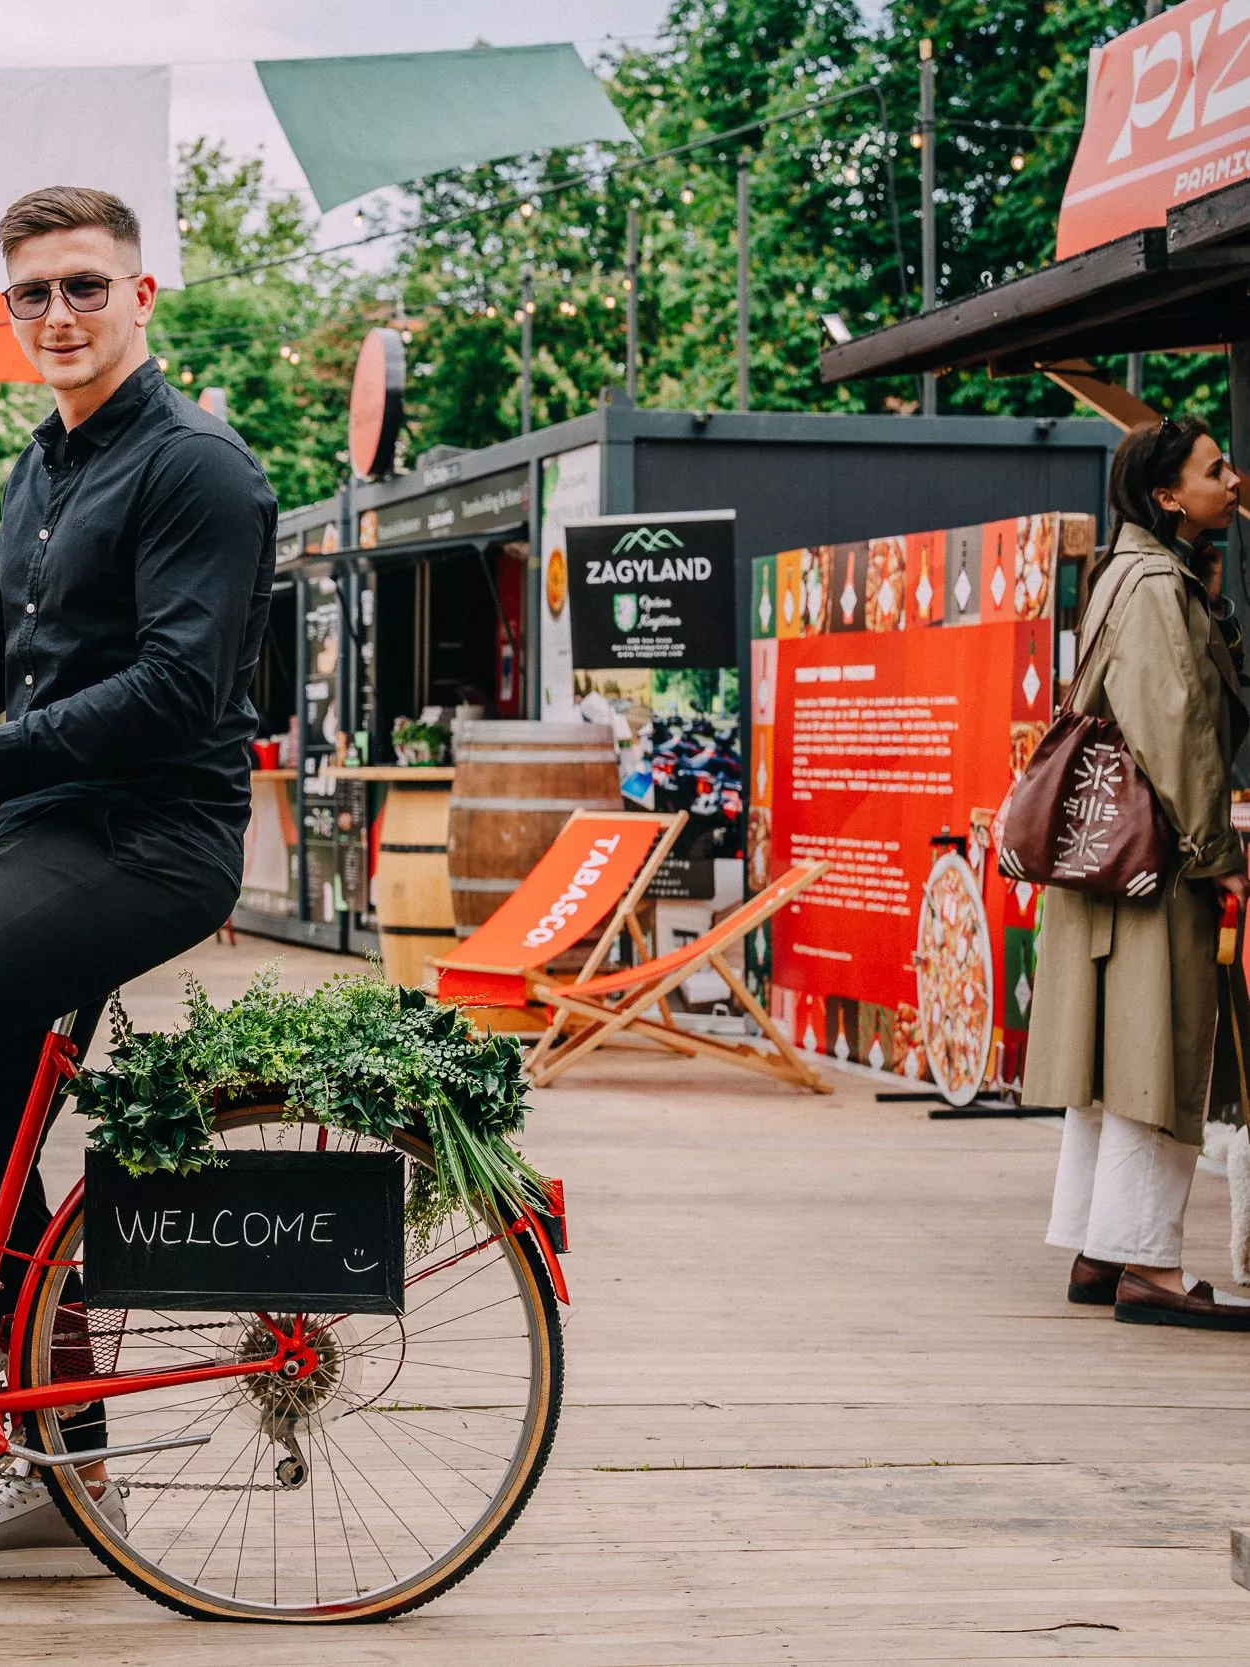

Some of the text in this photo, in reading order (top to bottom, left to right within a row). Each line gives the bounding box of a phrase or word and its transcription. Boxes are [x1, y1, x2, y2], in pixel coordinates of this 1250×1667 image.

[585, 556, 713, 585] ZAGYLAND
[524, 833, 621, 945] TABASCO
[115, 1206, 337, 1247] WELCOME
